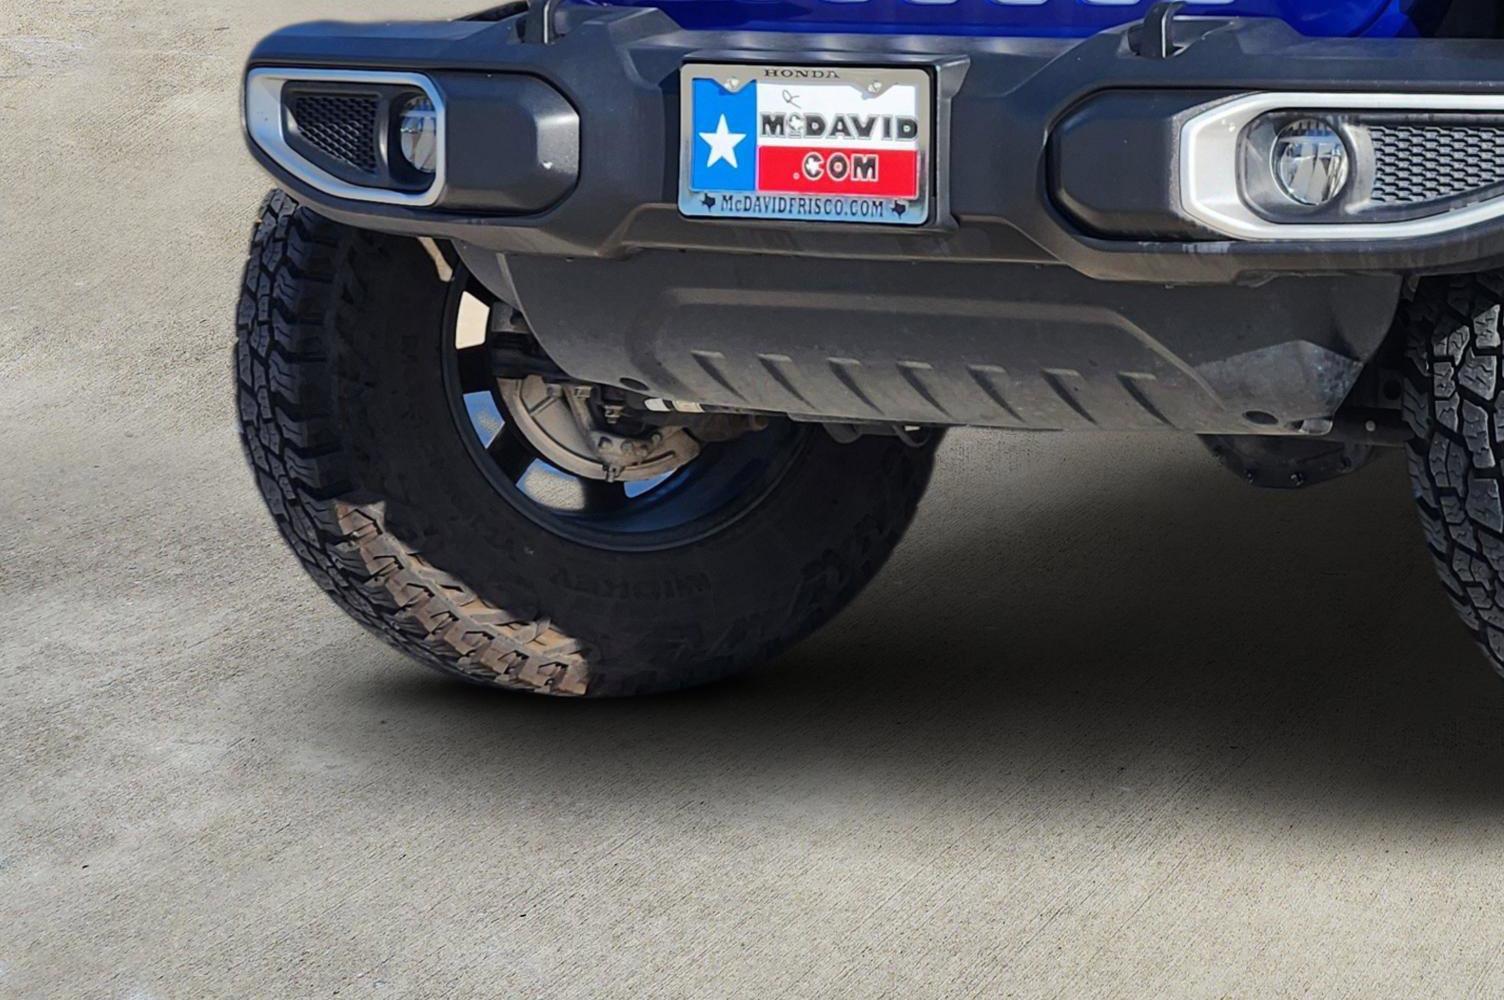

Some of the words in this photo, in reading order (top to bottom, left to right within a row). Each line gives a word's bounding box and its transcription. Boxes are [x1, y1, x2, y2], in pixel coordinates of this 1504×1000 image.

[763, 68, 840, 79] HONDA
[792, 151, 880, 182] .COM
[720, 194, 884, 218] McDAVIDFRISCO.COM
